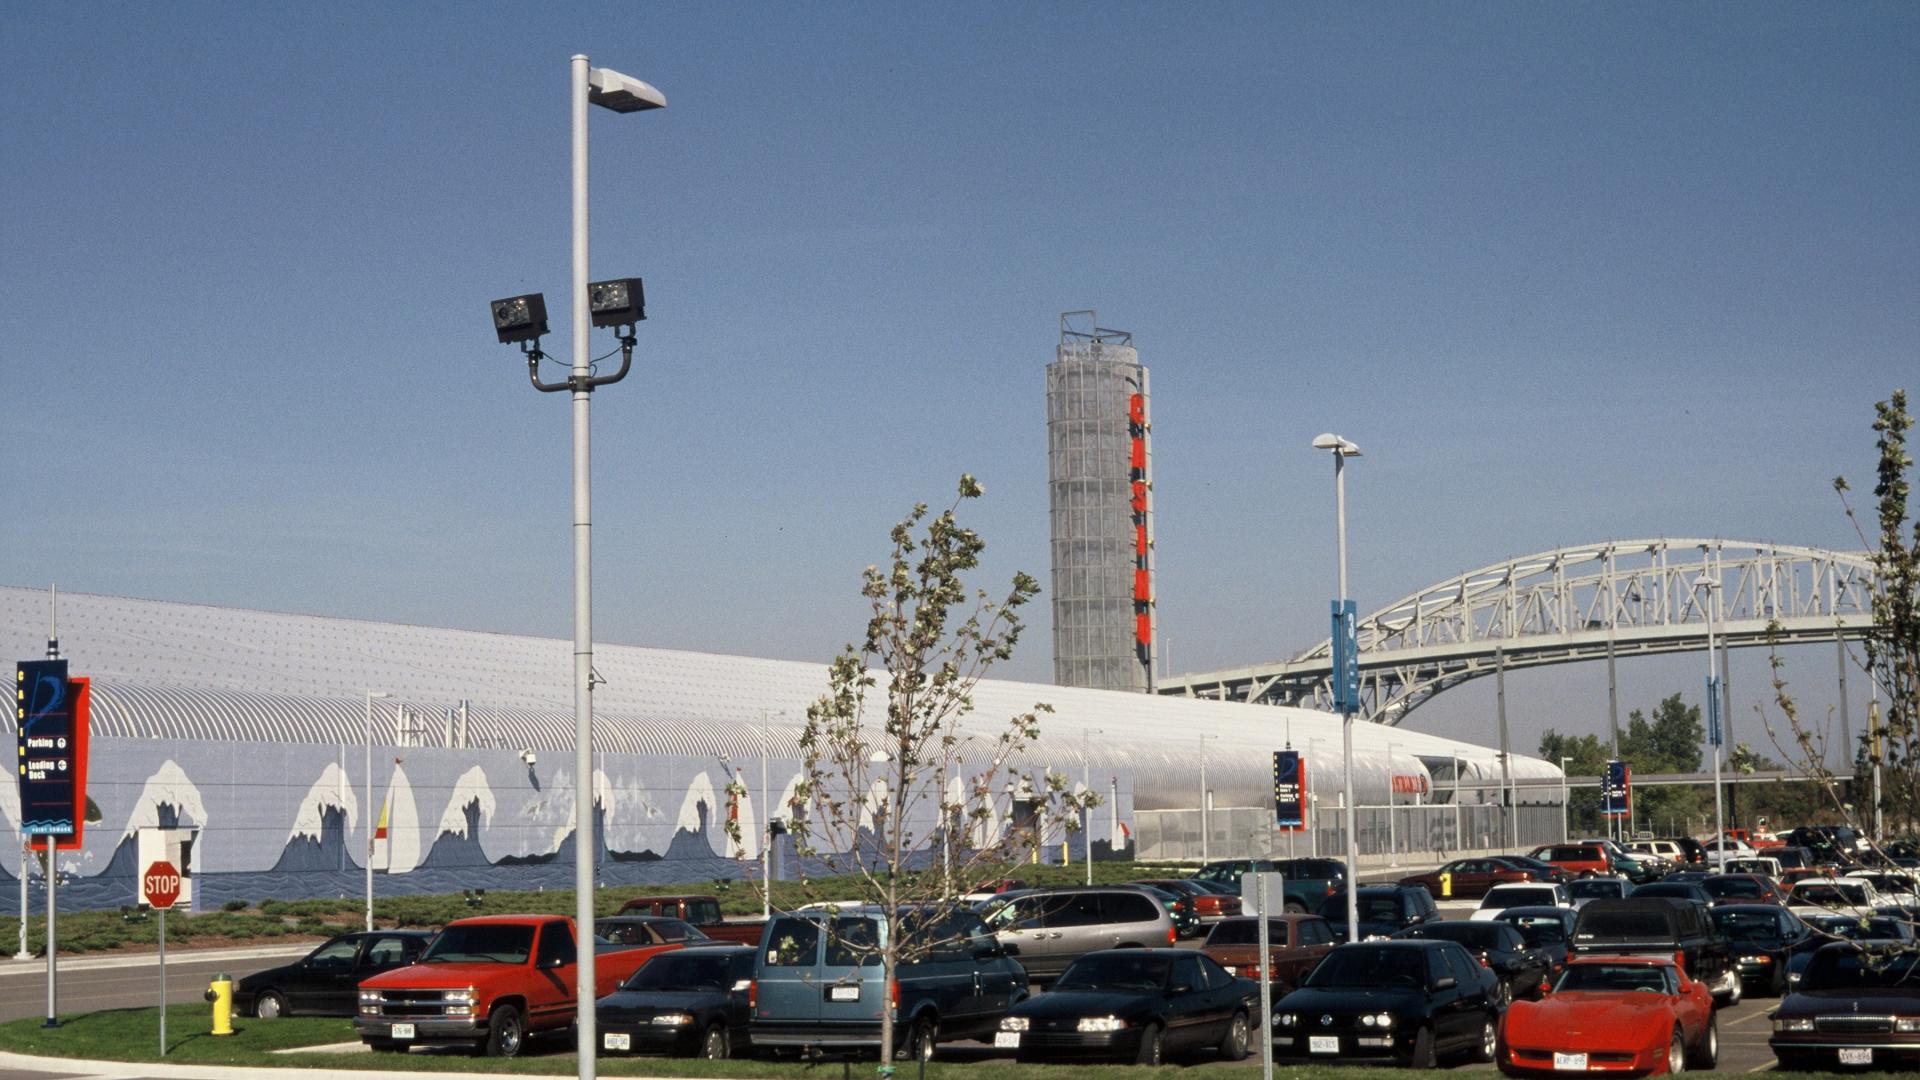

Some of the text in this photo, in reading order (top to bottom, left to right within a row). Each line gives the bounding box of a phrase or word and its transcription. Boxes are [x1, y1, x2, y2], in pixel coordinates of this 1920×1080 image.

[1348, 612, 1355, 639] 3
[27, 738, 54, 748] Parking
[28, 760, 55, 771] Loading
[28, 770, 46, 780] Dock
[146, 875, 179, 894] STOP
